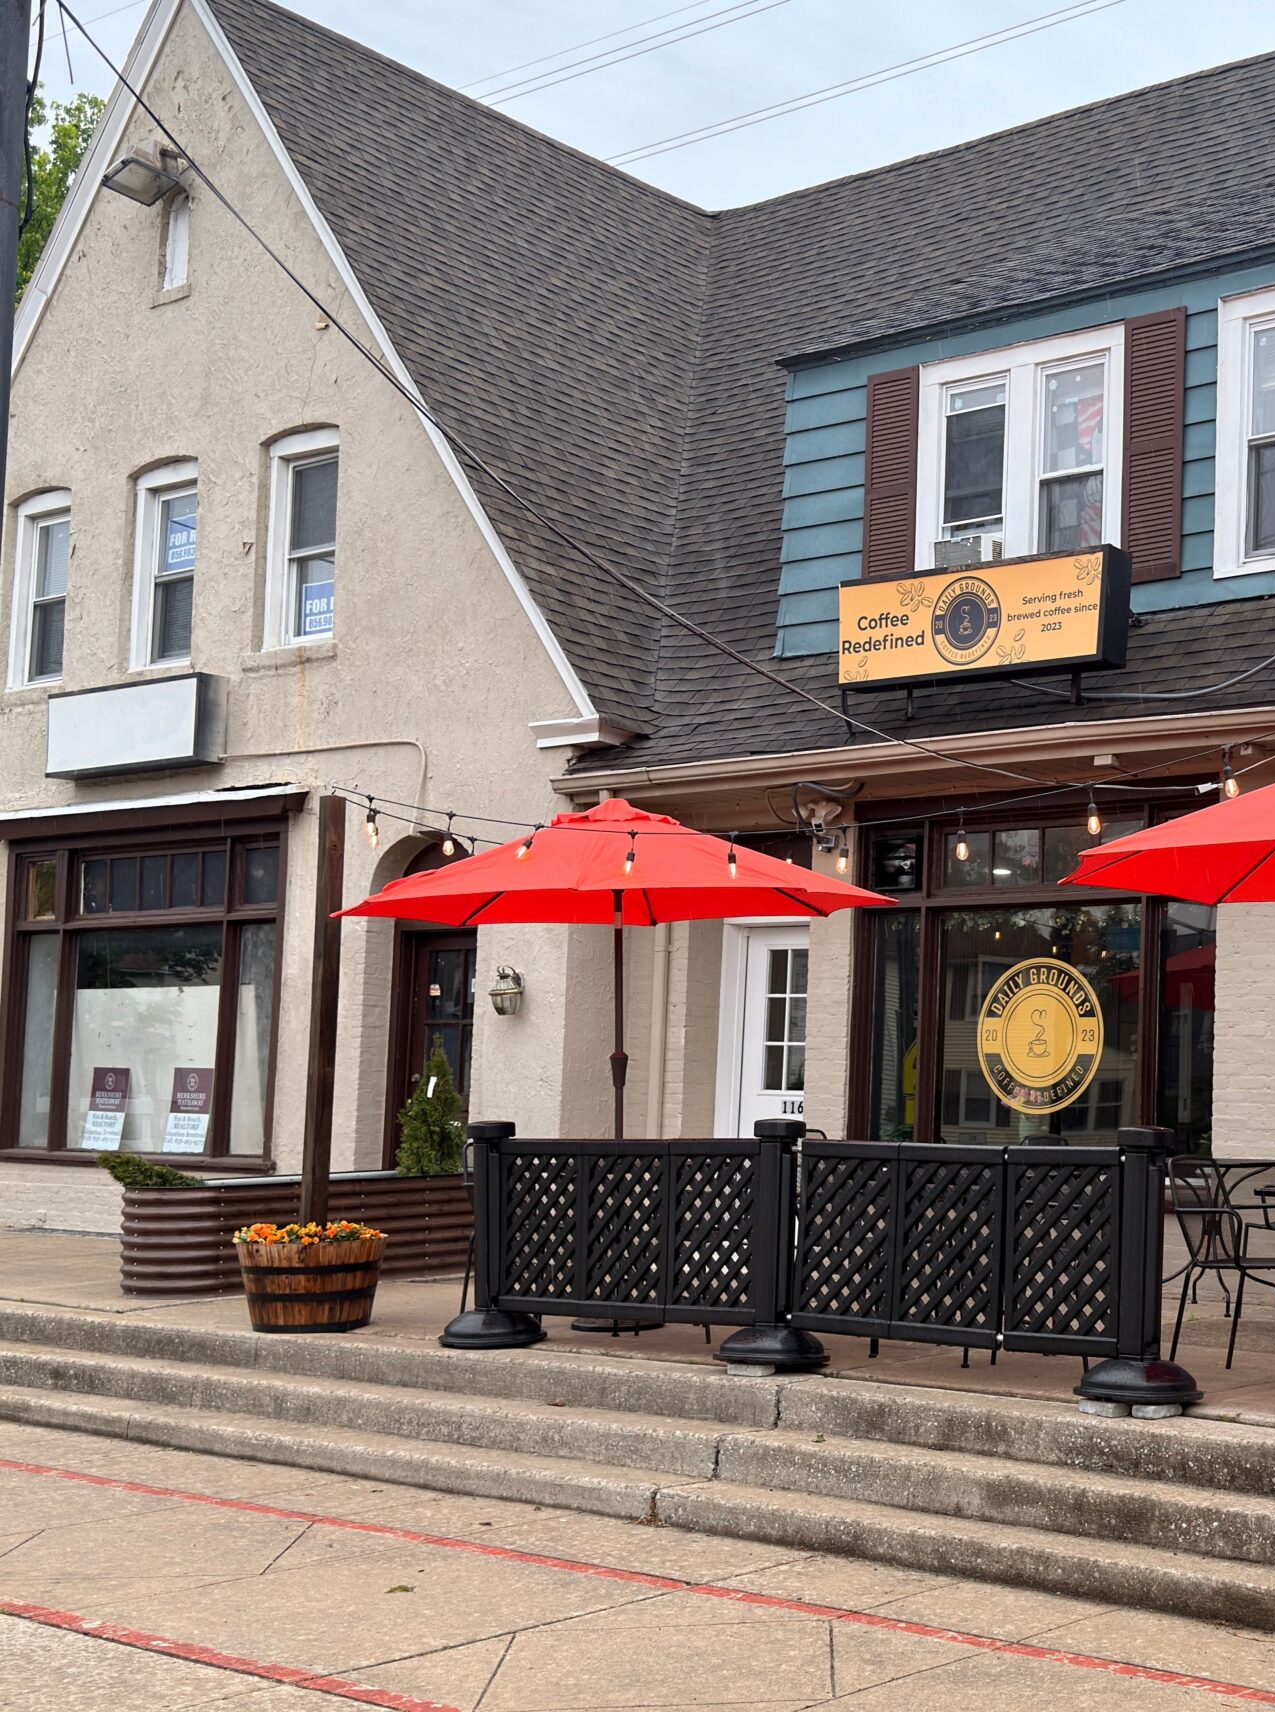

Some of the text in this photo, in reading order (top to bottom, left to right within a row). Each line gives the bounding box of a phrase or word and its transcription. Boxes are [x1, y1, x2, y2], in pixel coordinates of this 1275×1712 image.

[169, 531, 188, 547] FOR
[938, 581, 996, 613] DAILY GROUNDS
[1022, 588, 1084, 606] Serving fresh
[306, 598, 327, 614] FOR
[1007, 602, 1098, 622] brewed coffee since
[857, 612, 910, 631] Coffee
[935, 620, 943, 629] 20
[989, 613, 998, 623] 23
[1040, 622, 1062, 632] 2023
[842, 630, 925, 655] Redefined
[940, 641, 959, 660] COFFEE
[991, 968, 1091, 1016] DAILY GROUNDS
[985, 1029, 998, 1042] 20
[1081, 1029, 1095, 1042] 23
[1029, 1065, 1084, 1104] REDEFINED
[782, 1101, 804, 1114] 116
